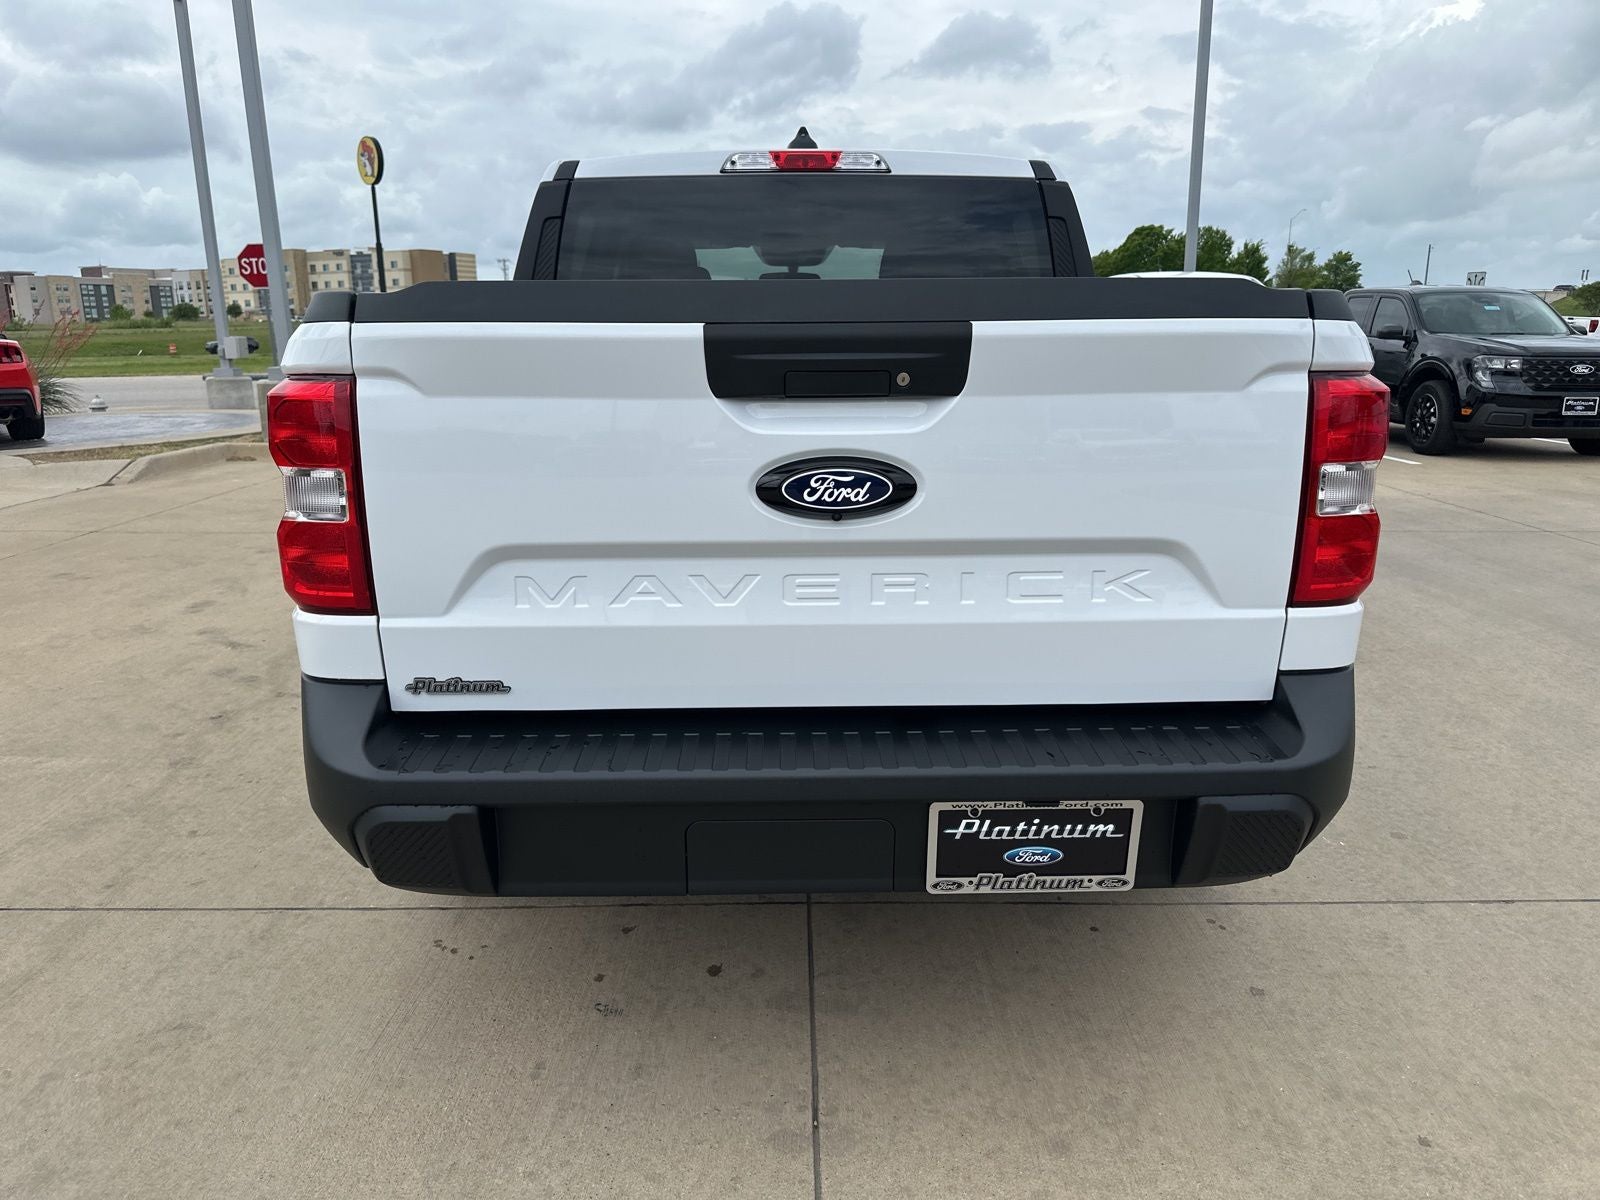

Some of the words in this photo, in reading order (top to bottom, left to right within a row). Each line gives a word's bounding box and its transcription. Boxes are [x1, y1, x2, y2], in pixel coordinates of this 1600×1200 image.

[241, 258, 268, 275] STO
[803, 474, 872, 502] Ford
[513, 568, 1153, 608] MAVERICK
[404, 677, 512, 695] Platinum
[943, 817, 1125, 840] Platinum
[1014, 849, 1052, 864] Ford
[936, 880, 959, 890] Ford
[974, 873, 1093, 891] Platinum
[1101, 878, 1126, 888] Ford
